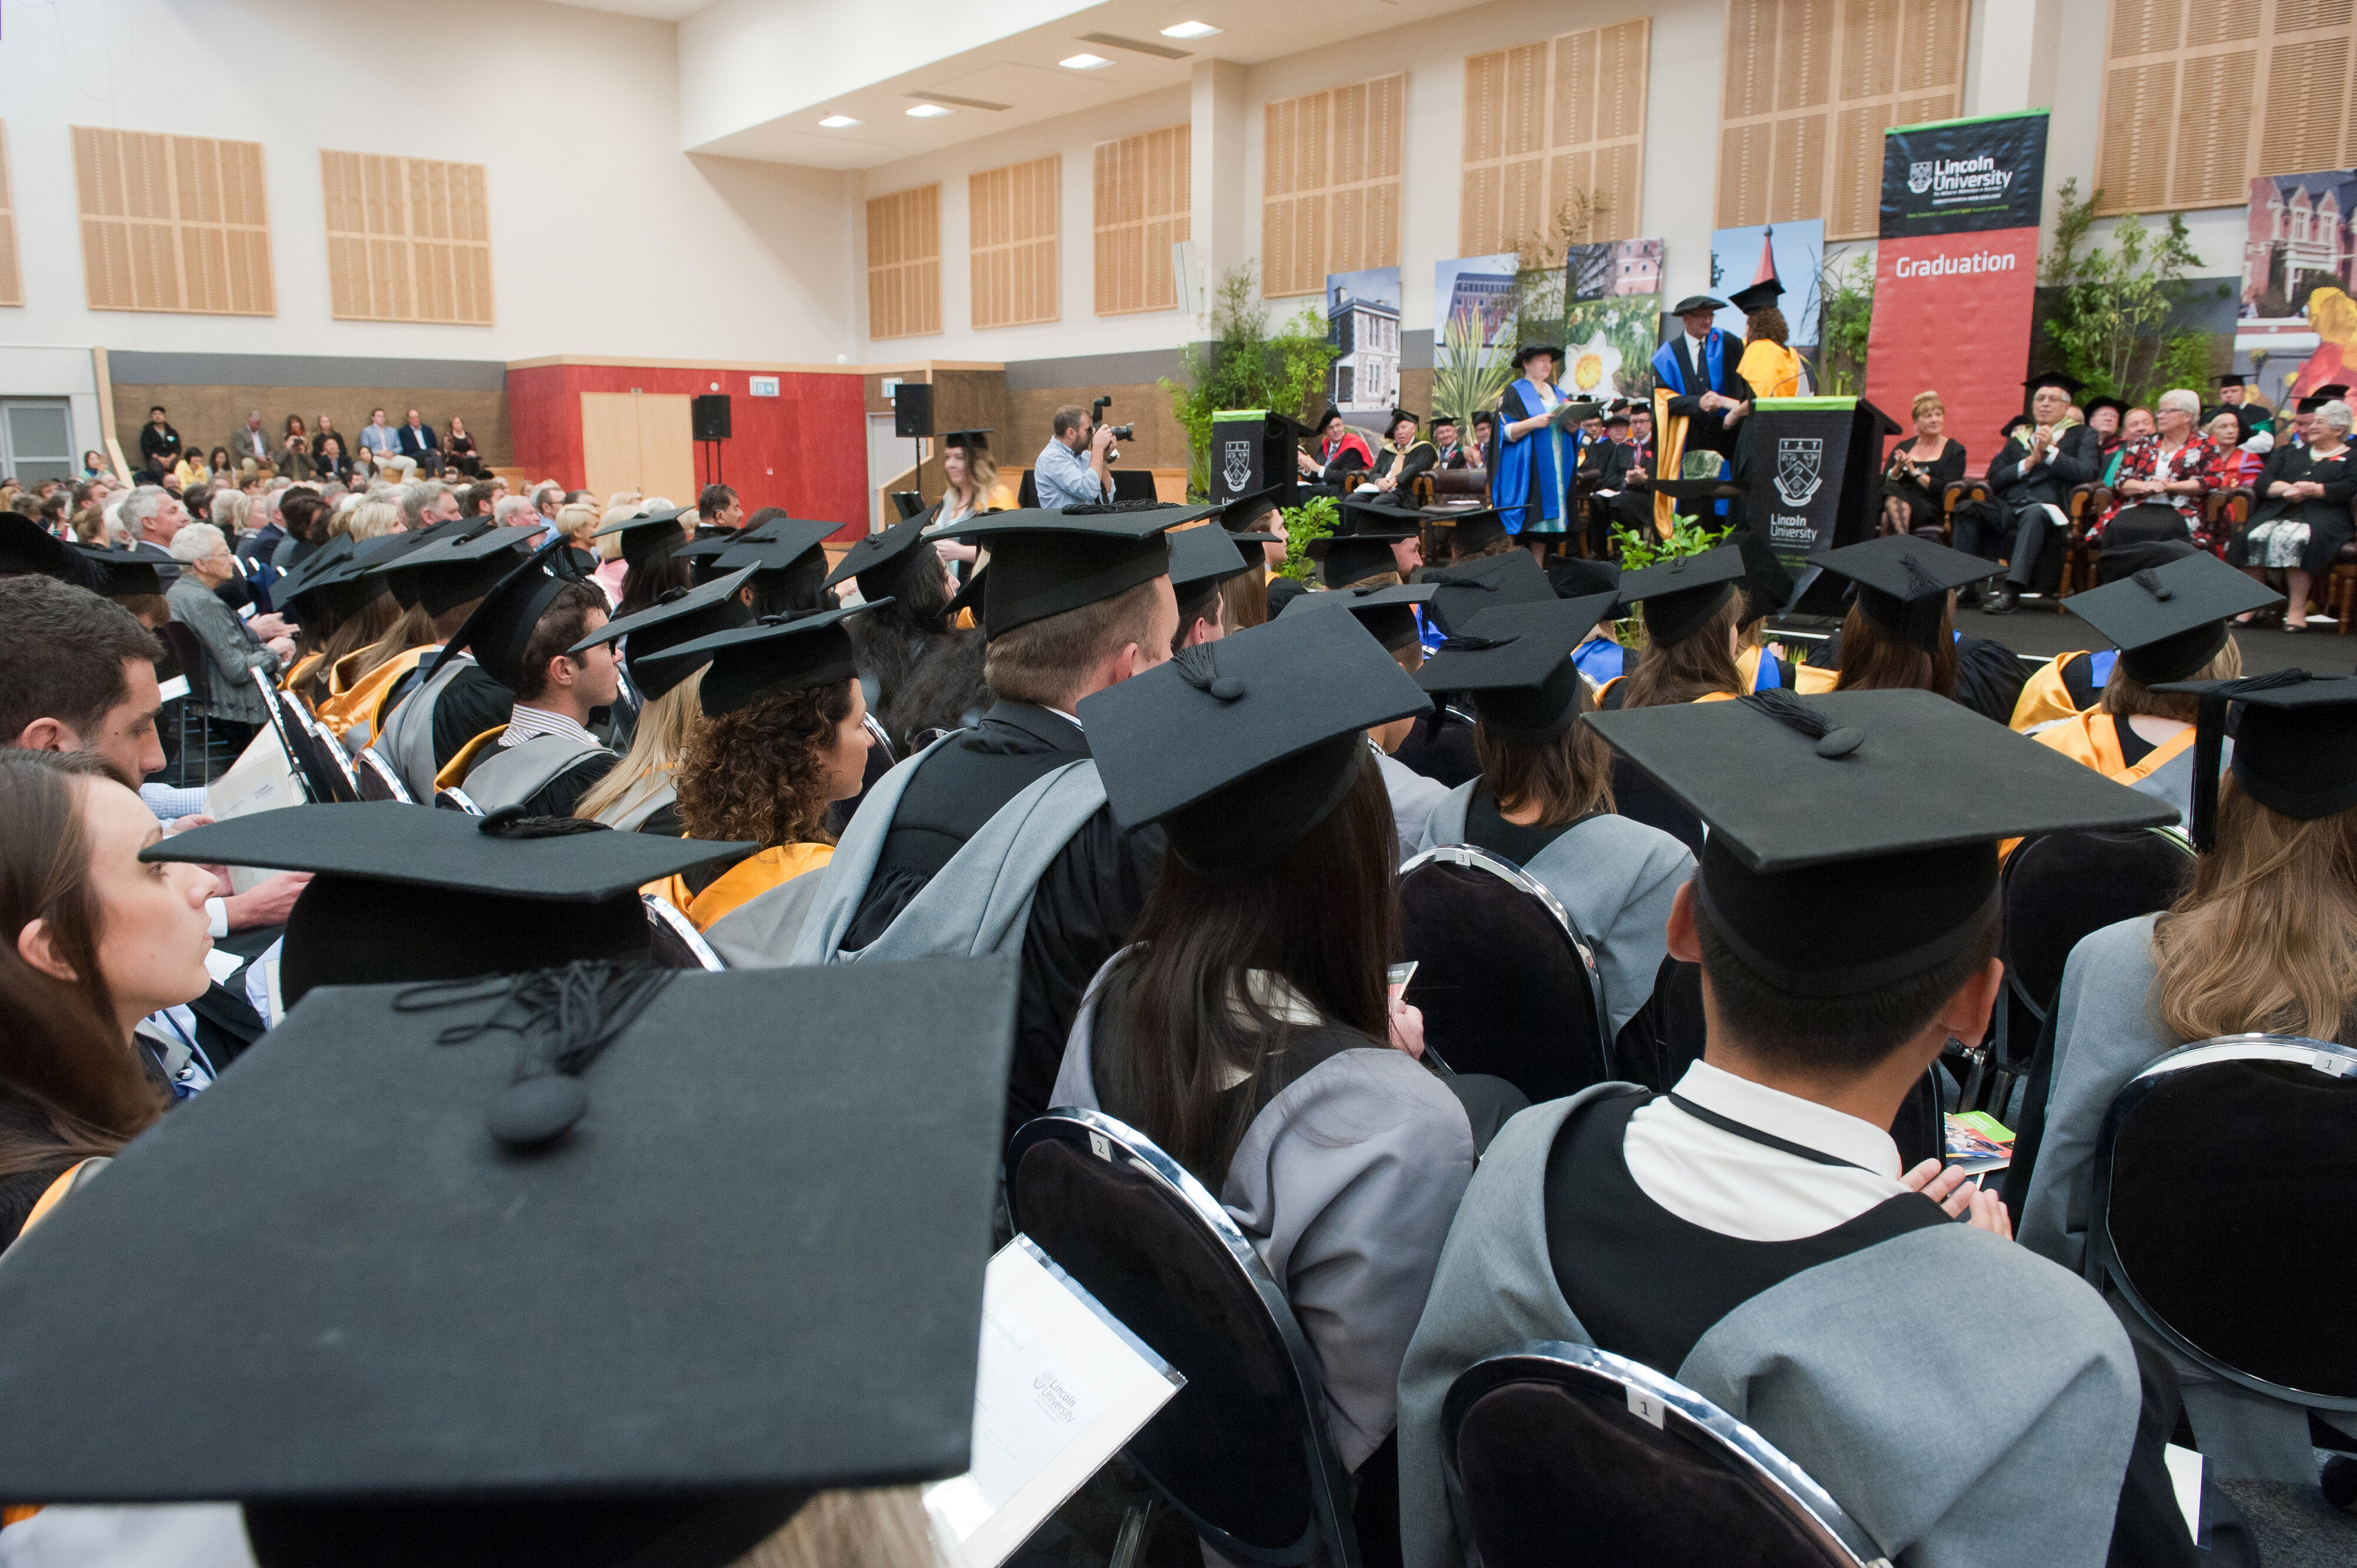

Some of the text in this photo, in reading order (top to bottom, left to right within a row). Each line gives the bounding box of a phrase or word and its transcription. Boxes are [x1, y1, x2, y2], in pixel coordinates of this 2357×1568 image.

[1934, 155, 1995, 176] Lincoln
[1933, 170, 2013, 191] University
[1896, 250, 2016, 278] Graduation
[1771, 513, 1807, 527] Lincoln
[1770, 526, 1818, 542] University
[1460, 854, 1465, 862] 3
[2323, 1059, 2332, 1071] 1
[1097, 1140, 1104, 1154] 2
[1049, 1379, 1076, 1408] Lincoln
[1041, 1387, 1076, 1424] University
[1640, 1401, 1650, 1417] 1
